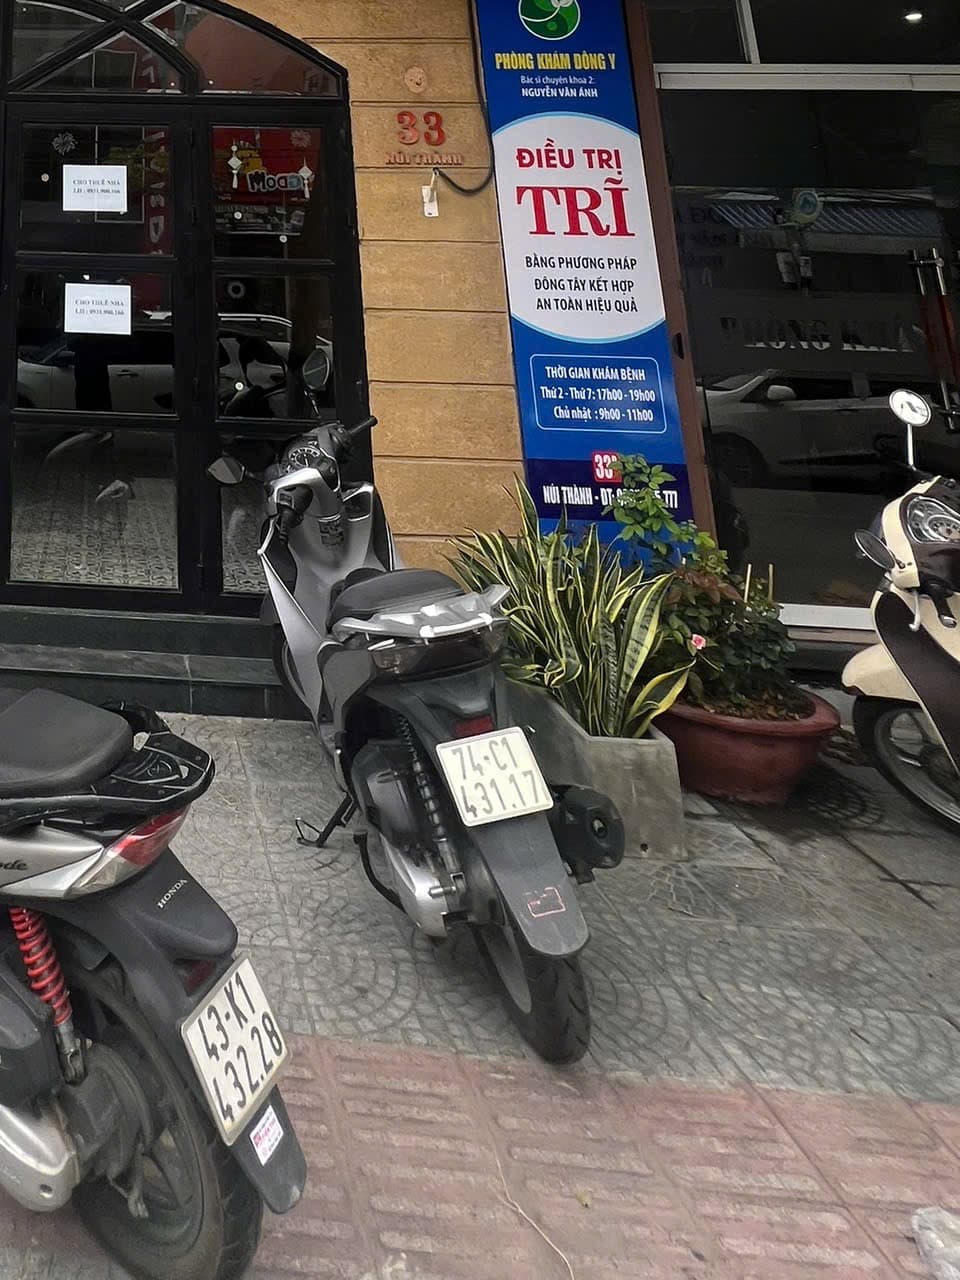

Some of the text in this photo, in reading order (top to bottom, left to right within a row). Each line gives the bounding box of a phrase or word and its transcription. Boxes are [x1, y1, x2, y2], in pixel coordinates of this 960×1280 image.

[494, 50, 535, 70] PHÒNG
[536, 50, 572, 70] KHÁM
[607, 53, 616, 70] Y
[569, 75, 587, 85] khoa
[521, 85, 558, 98] NGUYỄN
[396, 110, 447, 147] 33
[515, 137, 623, 176] ĐIỀU TRỊ
[515, 177, 636, 237] TRĨ
[525, 253, 638, 271] BẰNG PHƯƠNG PHÁP
[534, 275, 634, 296] ĐÔNG TÂY KẾT HỢP
[536, 296, 639, 315] AN TOÀN HIỆU QUẢ
[544, 366, 646, 383] THỜI GIAN KHÁM BỆNH
[540, 386, 558, 399] Thứ
[558, 387, 564, 400] 2
[569, 387, 587, 400] Thứ
[597, 388, 623, 402] 17h00
[629, 389, 656, 402] 19h00
[553, 405, 571, 420] Chủ
[571, 406, 592, 422] nhật
[599, 409, 621, 421] 9h00
[628, 409, 654, 422] 11h00
[542, 483, 560, 504] NÚI
[562, 483, 594, 506] THÀNH
[460, 771, 539, 818] 431.17
[157, 878, 189, 910] HONDA
[197, 970, 257, 1063] 43-K1
[211, 1011, 283, 1124] 432.28
